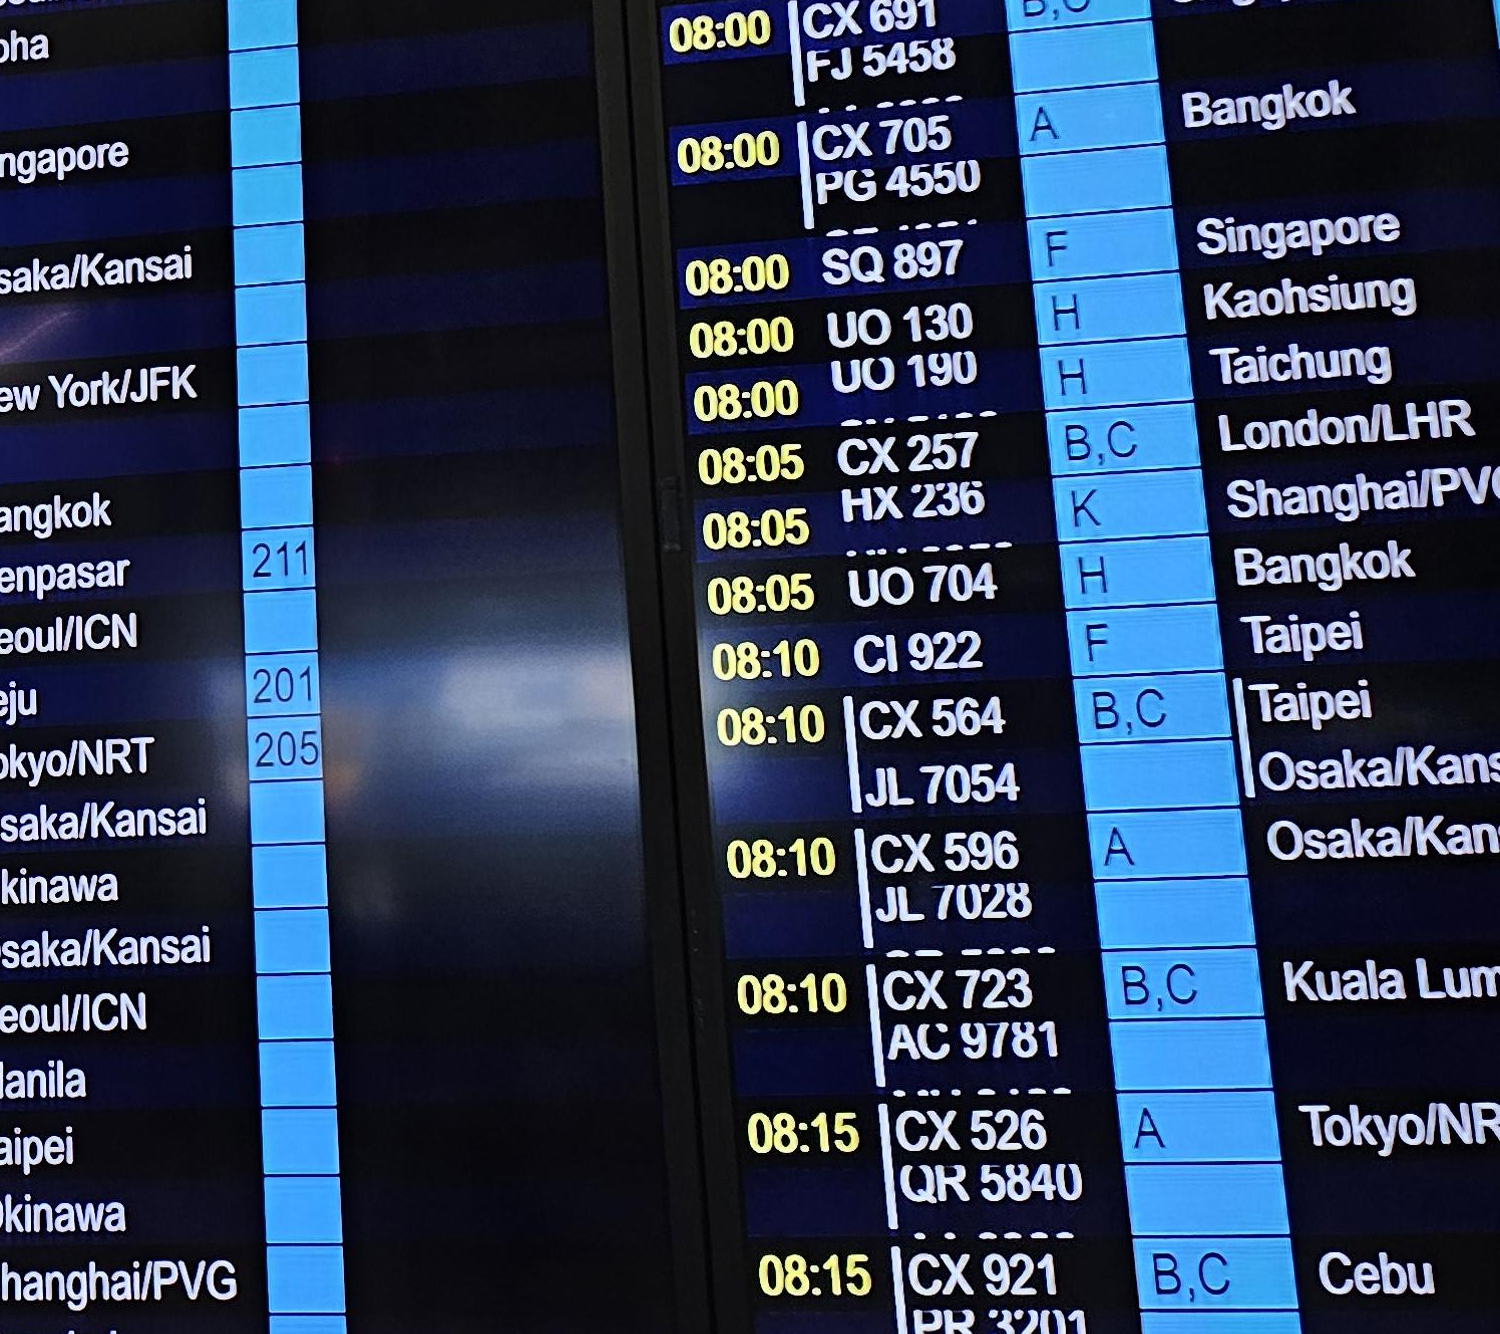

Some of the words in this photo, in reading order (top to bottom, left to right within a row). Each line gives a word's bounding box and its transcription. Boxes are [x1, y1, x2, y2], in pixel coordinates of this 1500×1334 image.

[47, 364, 198, 409] York/JFK
[698, 443, 805, 486] 08:05
[837, 436, 900, 476] CX
[906, 431, 979, 472] 257
[1217, 399, 1477, 452] London/LHR
[1239, 610, 1364, 662] Taipei
[255, 730, 319, 768] 205
[758, 1253, 872, 1297] 08:15
[907, 1252, 975, 1297] CX
[982, 1252, 1057, 1297] 921
[1152, 1251, 1231, 1303] B,C
[1318, 1251, 1436, 1295] Cebu
